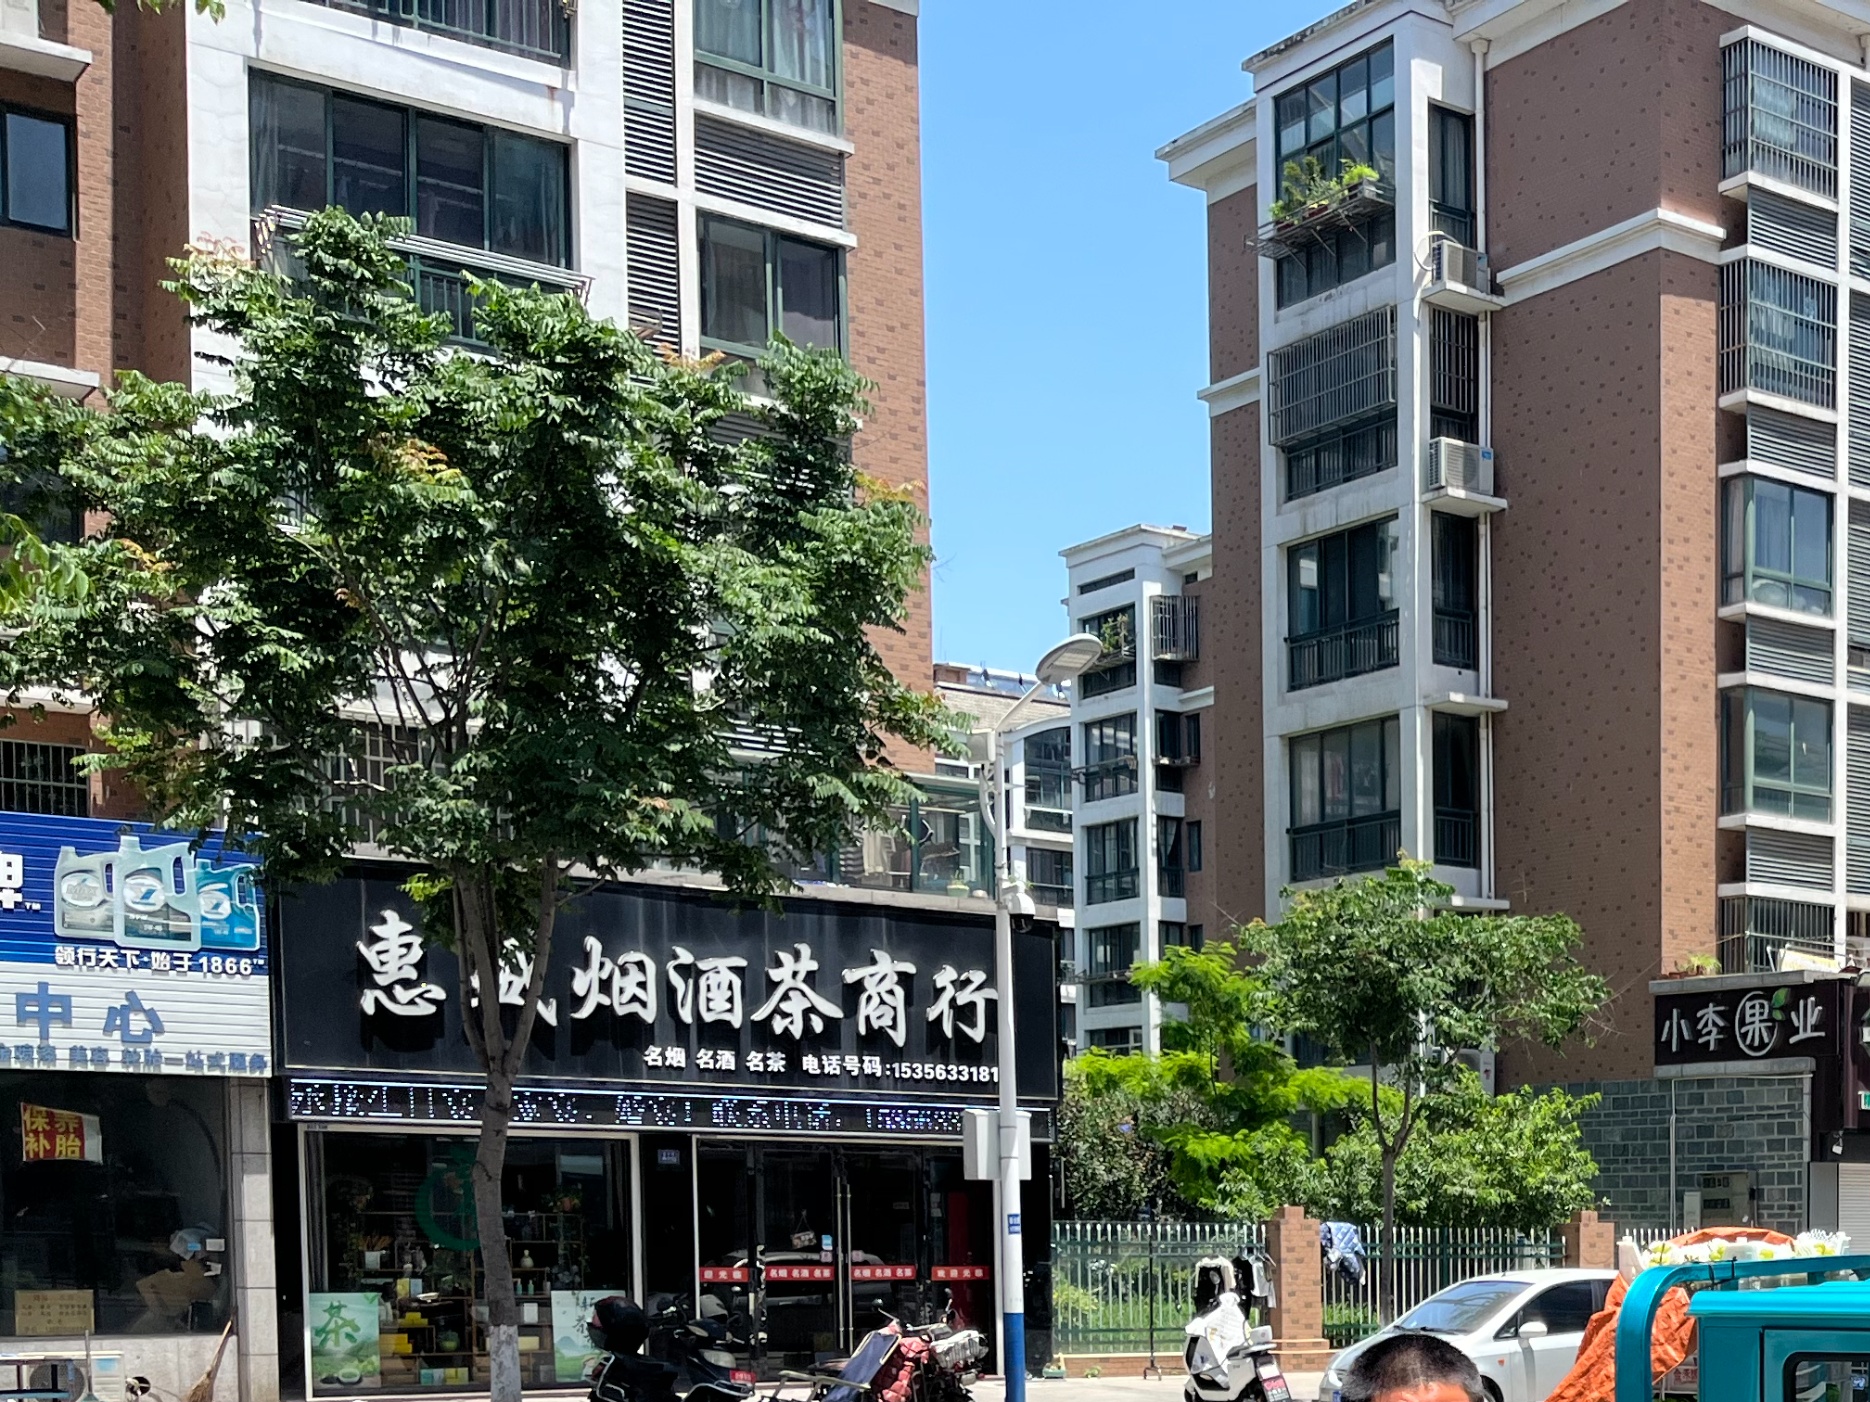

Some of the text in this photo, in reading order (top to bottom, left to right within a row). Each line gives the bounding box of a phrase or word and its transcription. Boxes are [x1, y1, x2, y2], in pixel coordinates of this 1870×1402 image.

[15, 981, 165, 1046] 中心
[1661, 996, 1826, 1056] 小李果业
[645, 1046, 686, 1068] 名烟
[696, 1048, 736, 1071] 名酒
[746, 1051, 786, 1072] 名茶
[24, 1104, 80, 1133] 保养
[25, 1134, 82, 1159] 补胎
